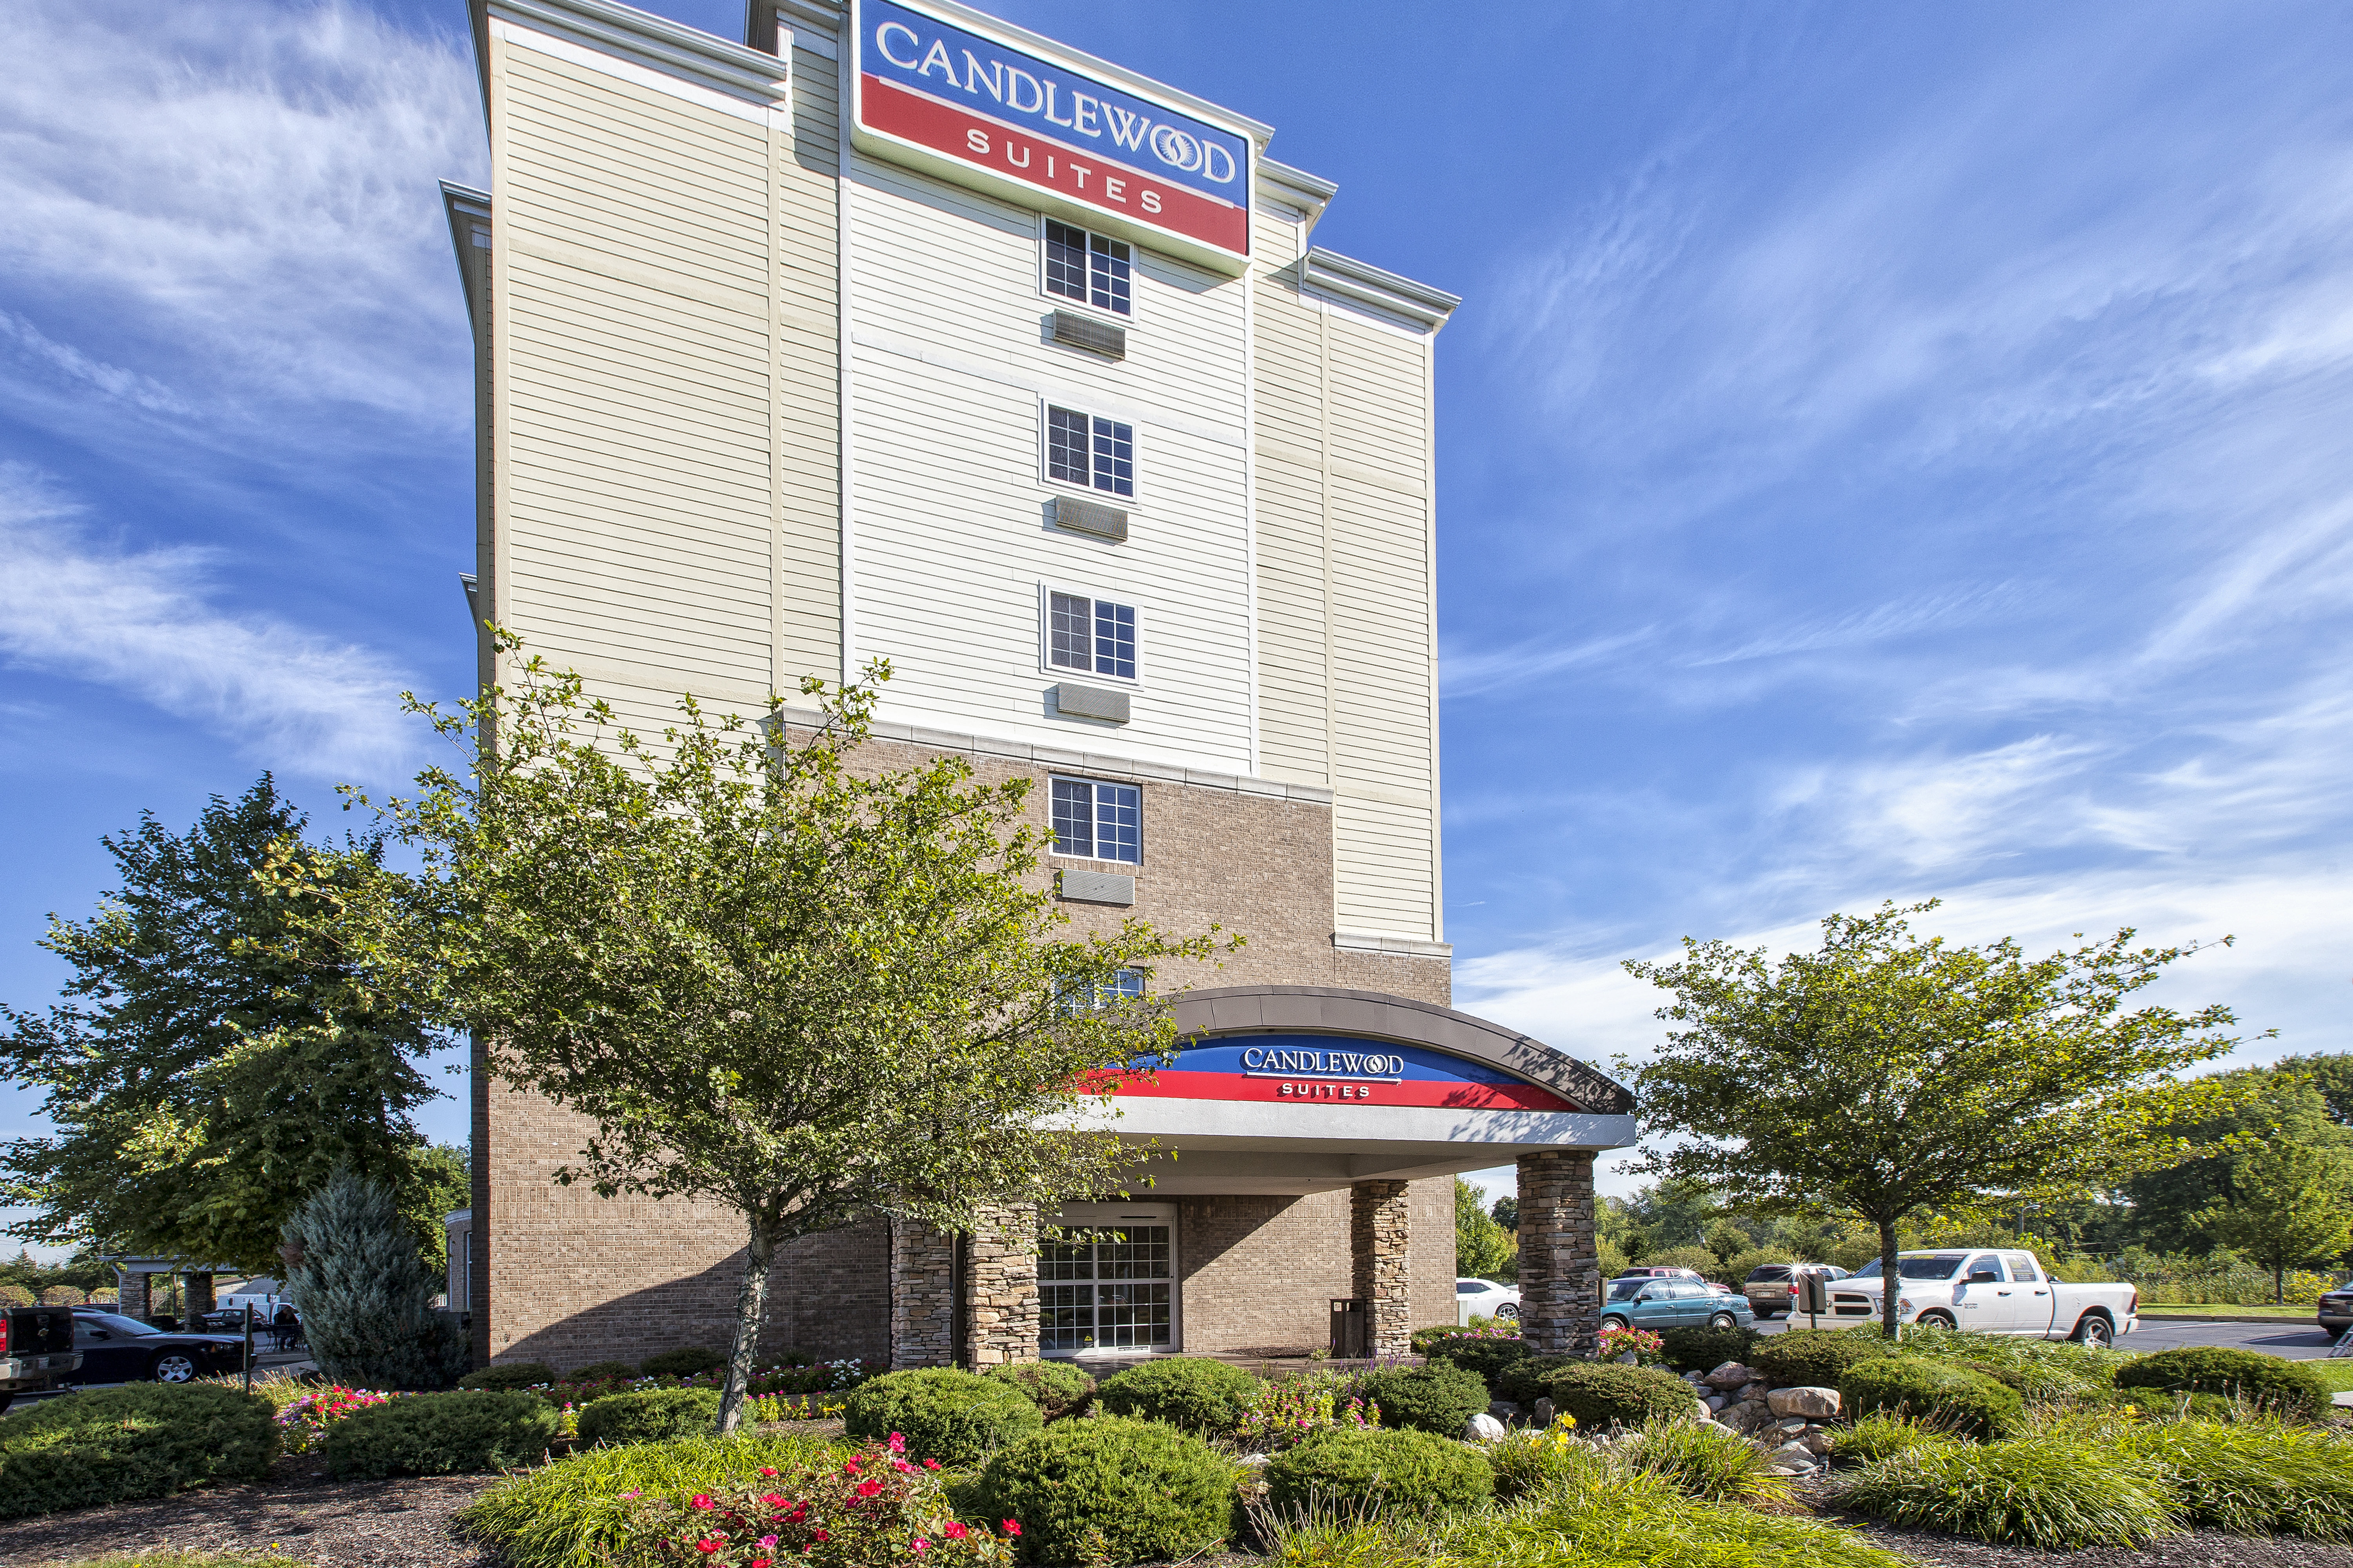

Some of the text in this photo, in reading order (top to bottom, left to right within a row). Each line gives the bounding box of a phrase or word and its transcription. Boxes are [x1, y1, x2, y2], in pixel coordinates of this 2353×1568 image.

[876, 22, 1236, 183] CANDLEWOOD
[966, 129, 1162, 214] SUITES
[1245, 1048, 1404, 1074] CANDLEWOOD
[1282, 1083, 1370, 1097] SUITES
